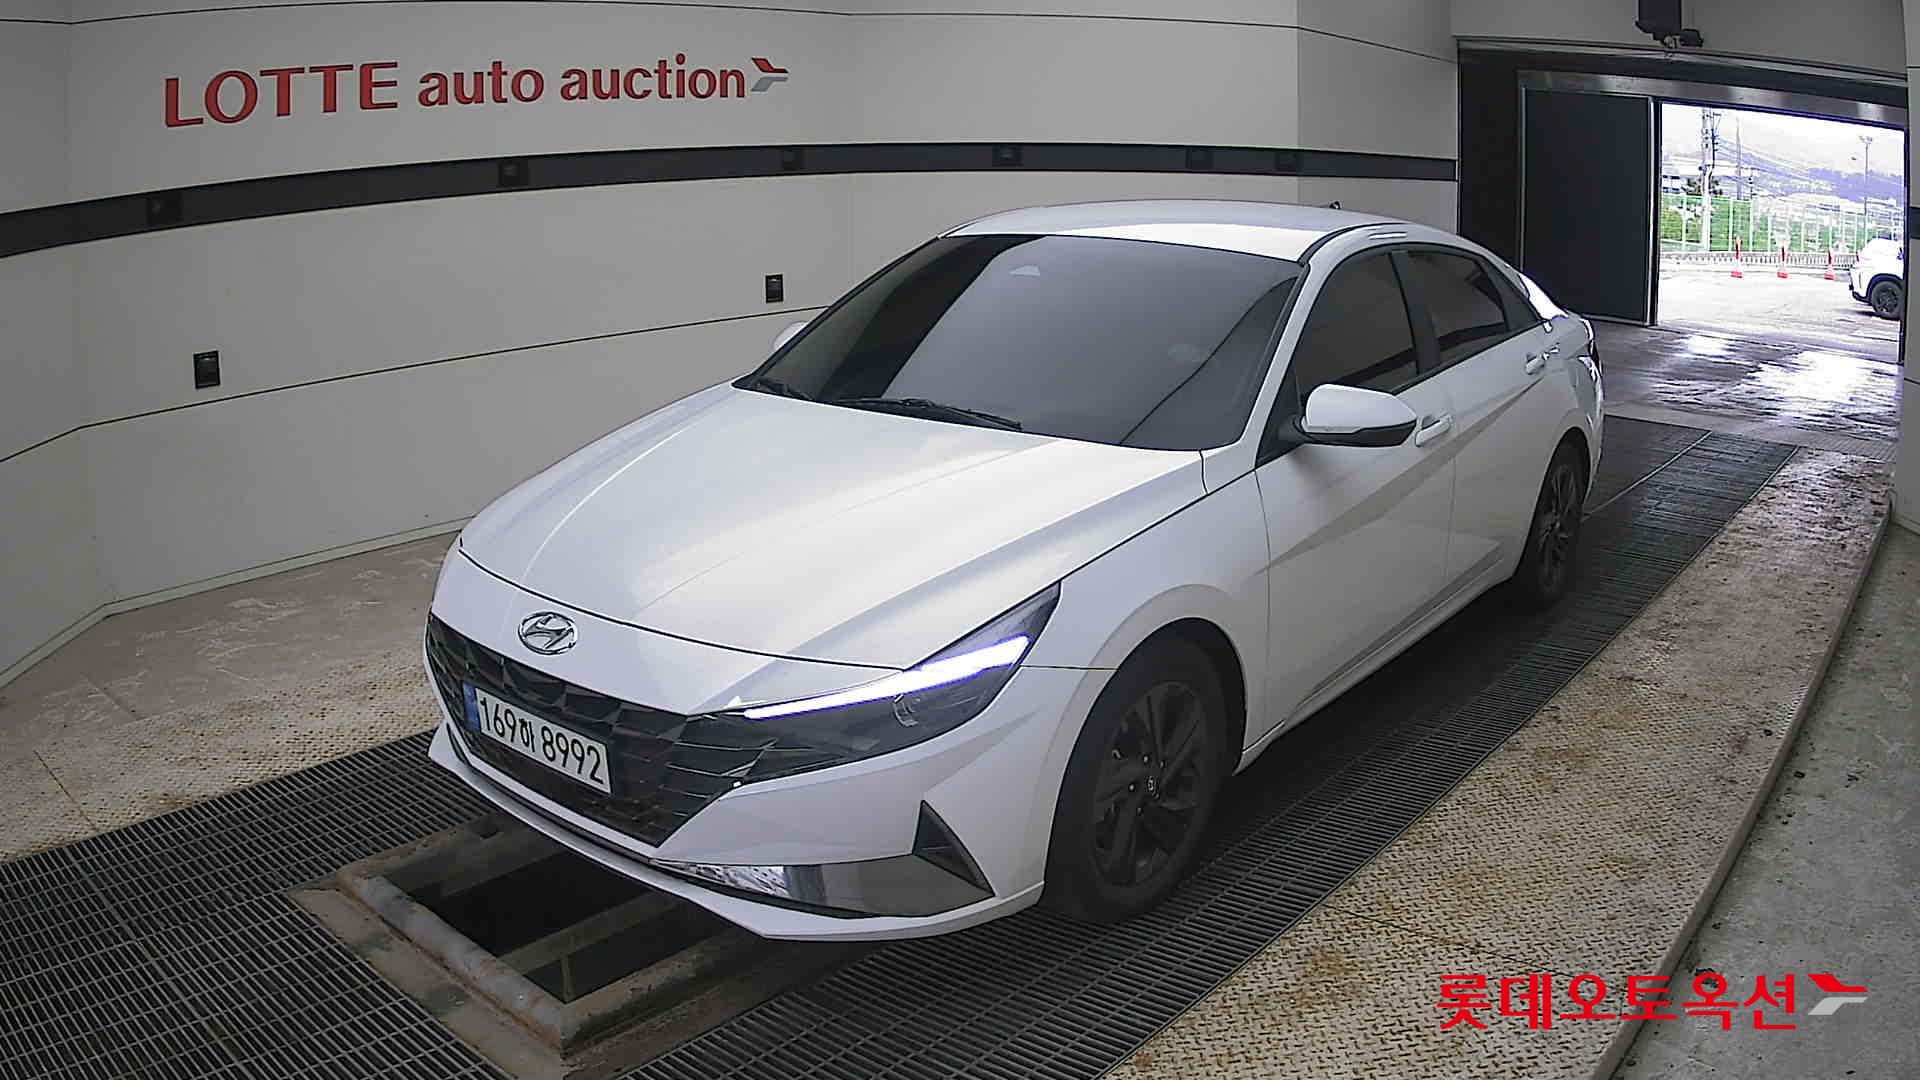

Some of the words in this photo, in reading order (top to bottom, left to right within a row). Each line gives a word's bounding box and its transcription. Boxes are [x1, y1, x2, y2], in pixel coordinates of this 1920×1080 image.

[164, 61, 399, 128] LOTTE
[418, 61, 545, 108] auto
[560, 53, 746, 101] auction
[541, 725, 604, 785] 8992
